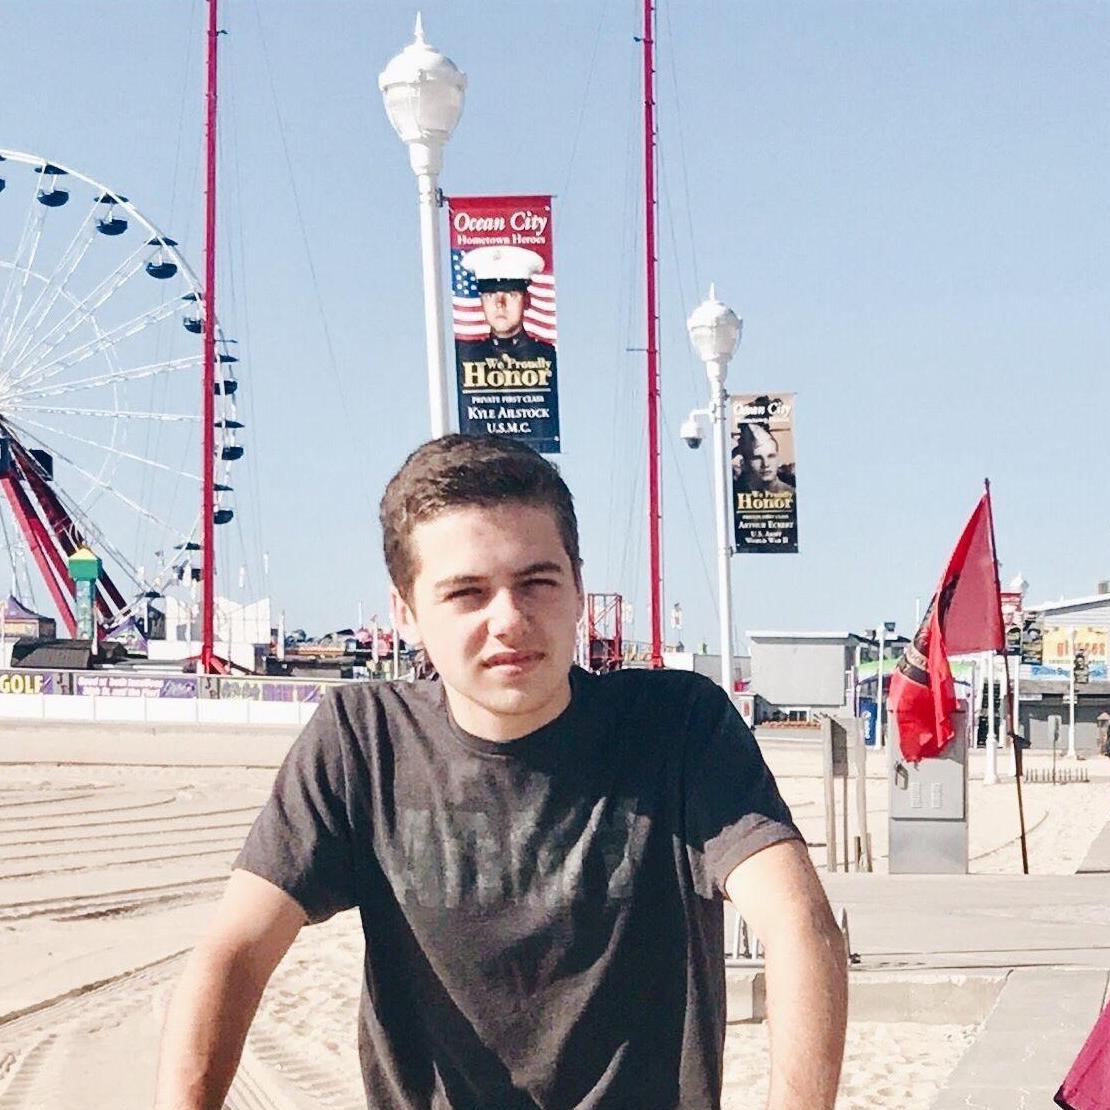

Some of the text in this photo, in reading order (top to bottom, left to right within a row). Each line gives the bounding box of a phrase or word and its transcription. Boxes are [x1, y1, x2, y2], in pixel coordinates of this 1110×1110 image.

[454, 210, 548, 236] Ocean City
[457, 233, 546, 245] Hometown Heroes
[462, 361, 551, 388] Honor
[467, 406, 497, 419] KYLE
[737, 492, 793, 509] Honor
[0, 673, 43, 695] GOLF
